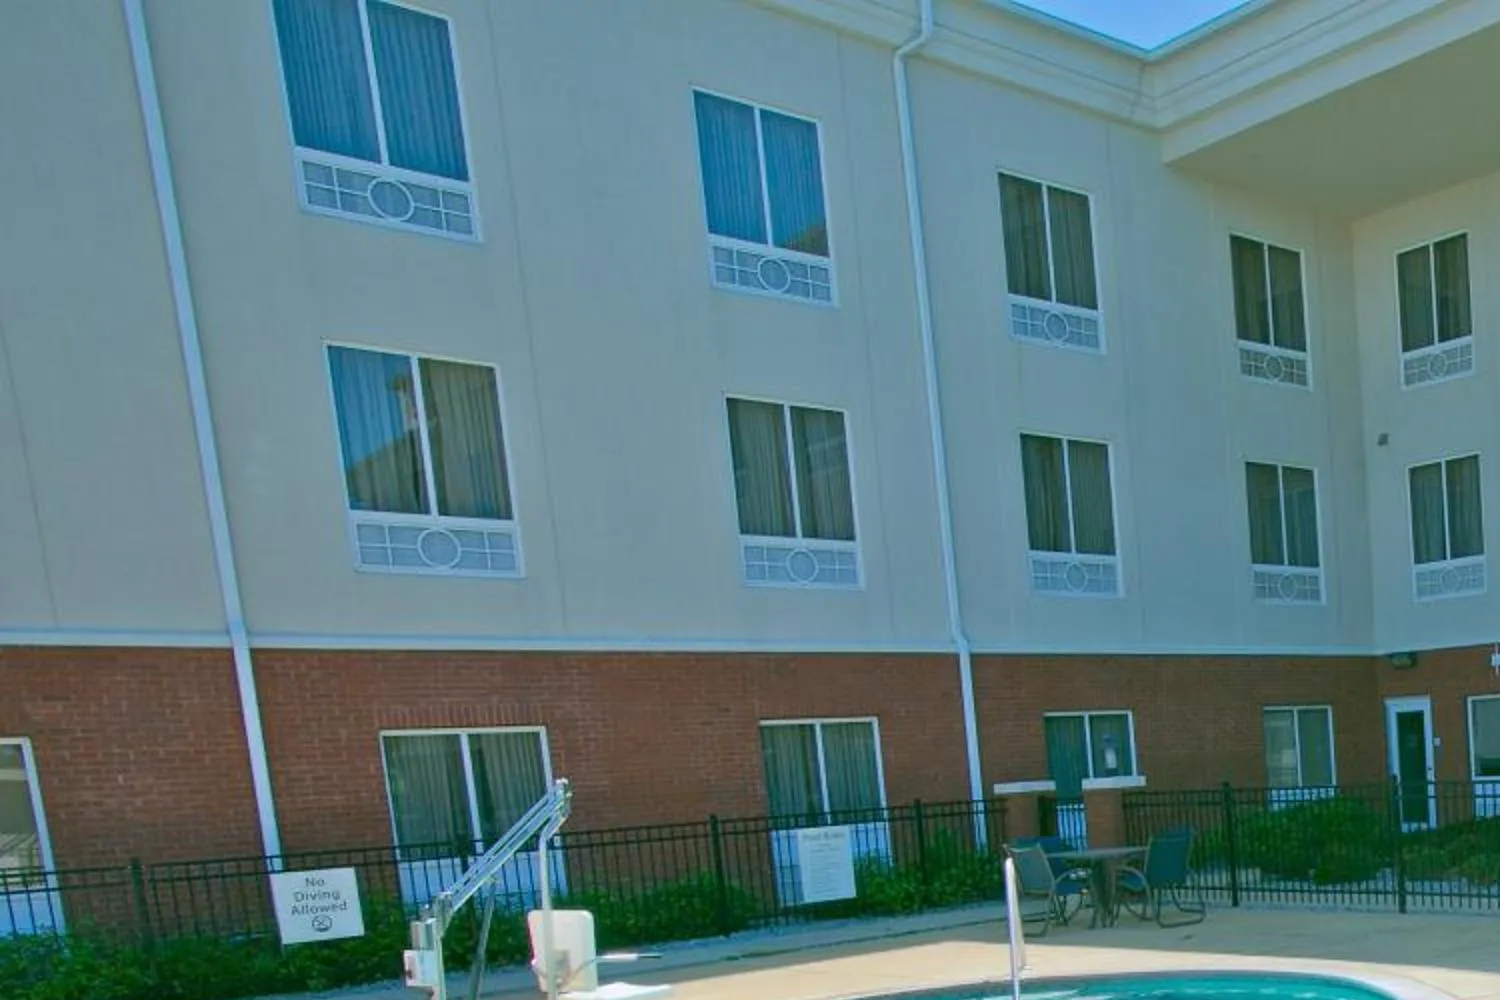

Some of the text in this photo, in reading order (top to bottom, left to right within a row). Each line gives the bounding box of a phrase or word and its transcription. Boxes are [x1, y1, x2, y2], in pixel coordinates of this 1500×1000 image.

[305, 877, 325, 887] No
[292, 889, 340, 902] Diving
[291, 900, 348, 916] Allowed
